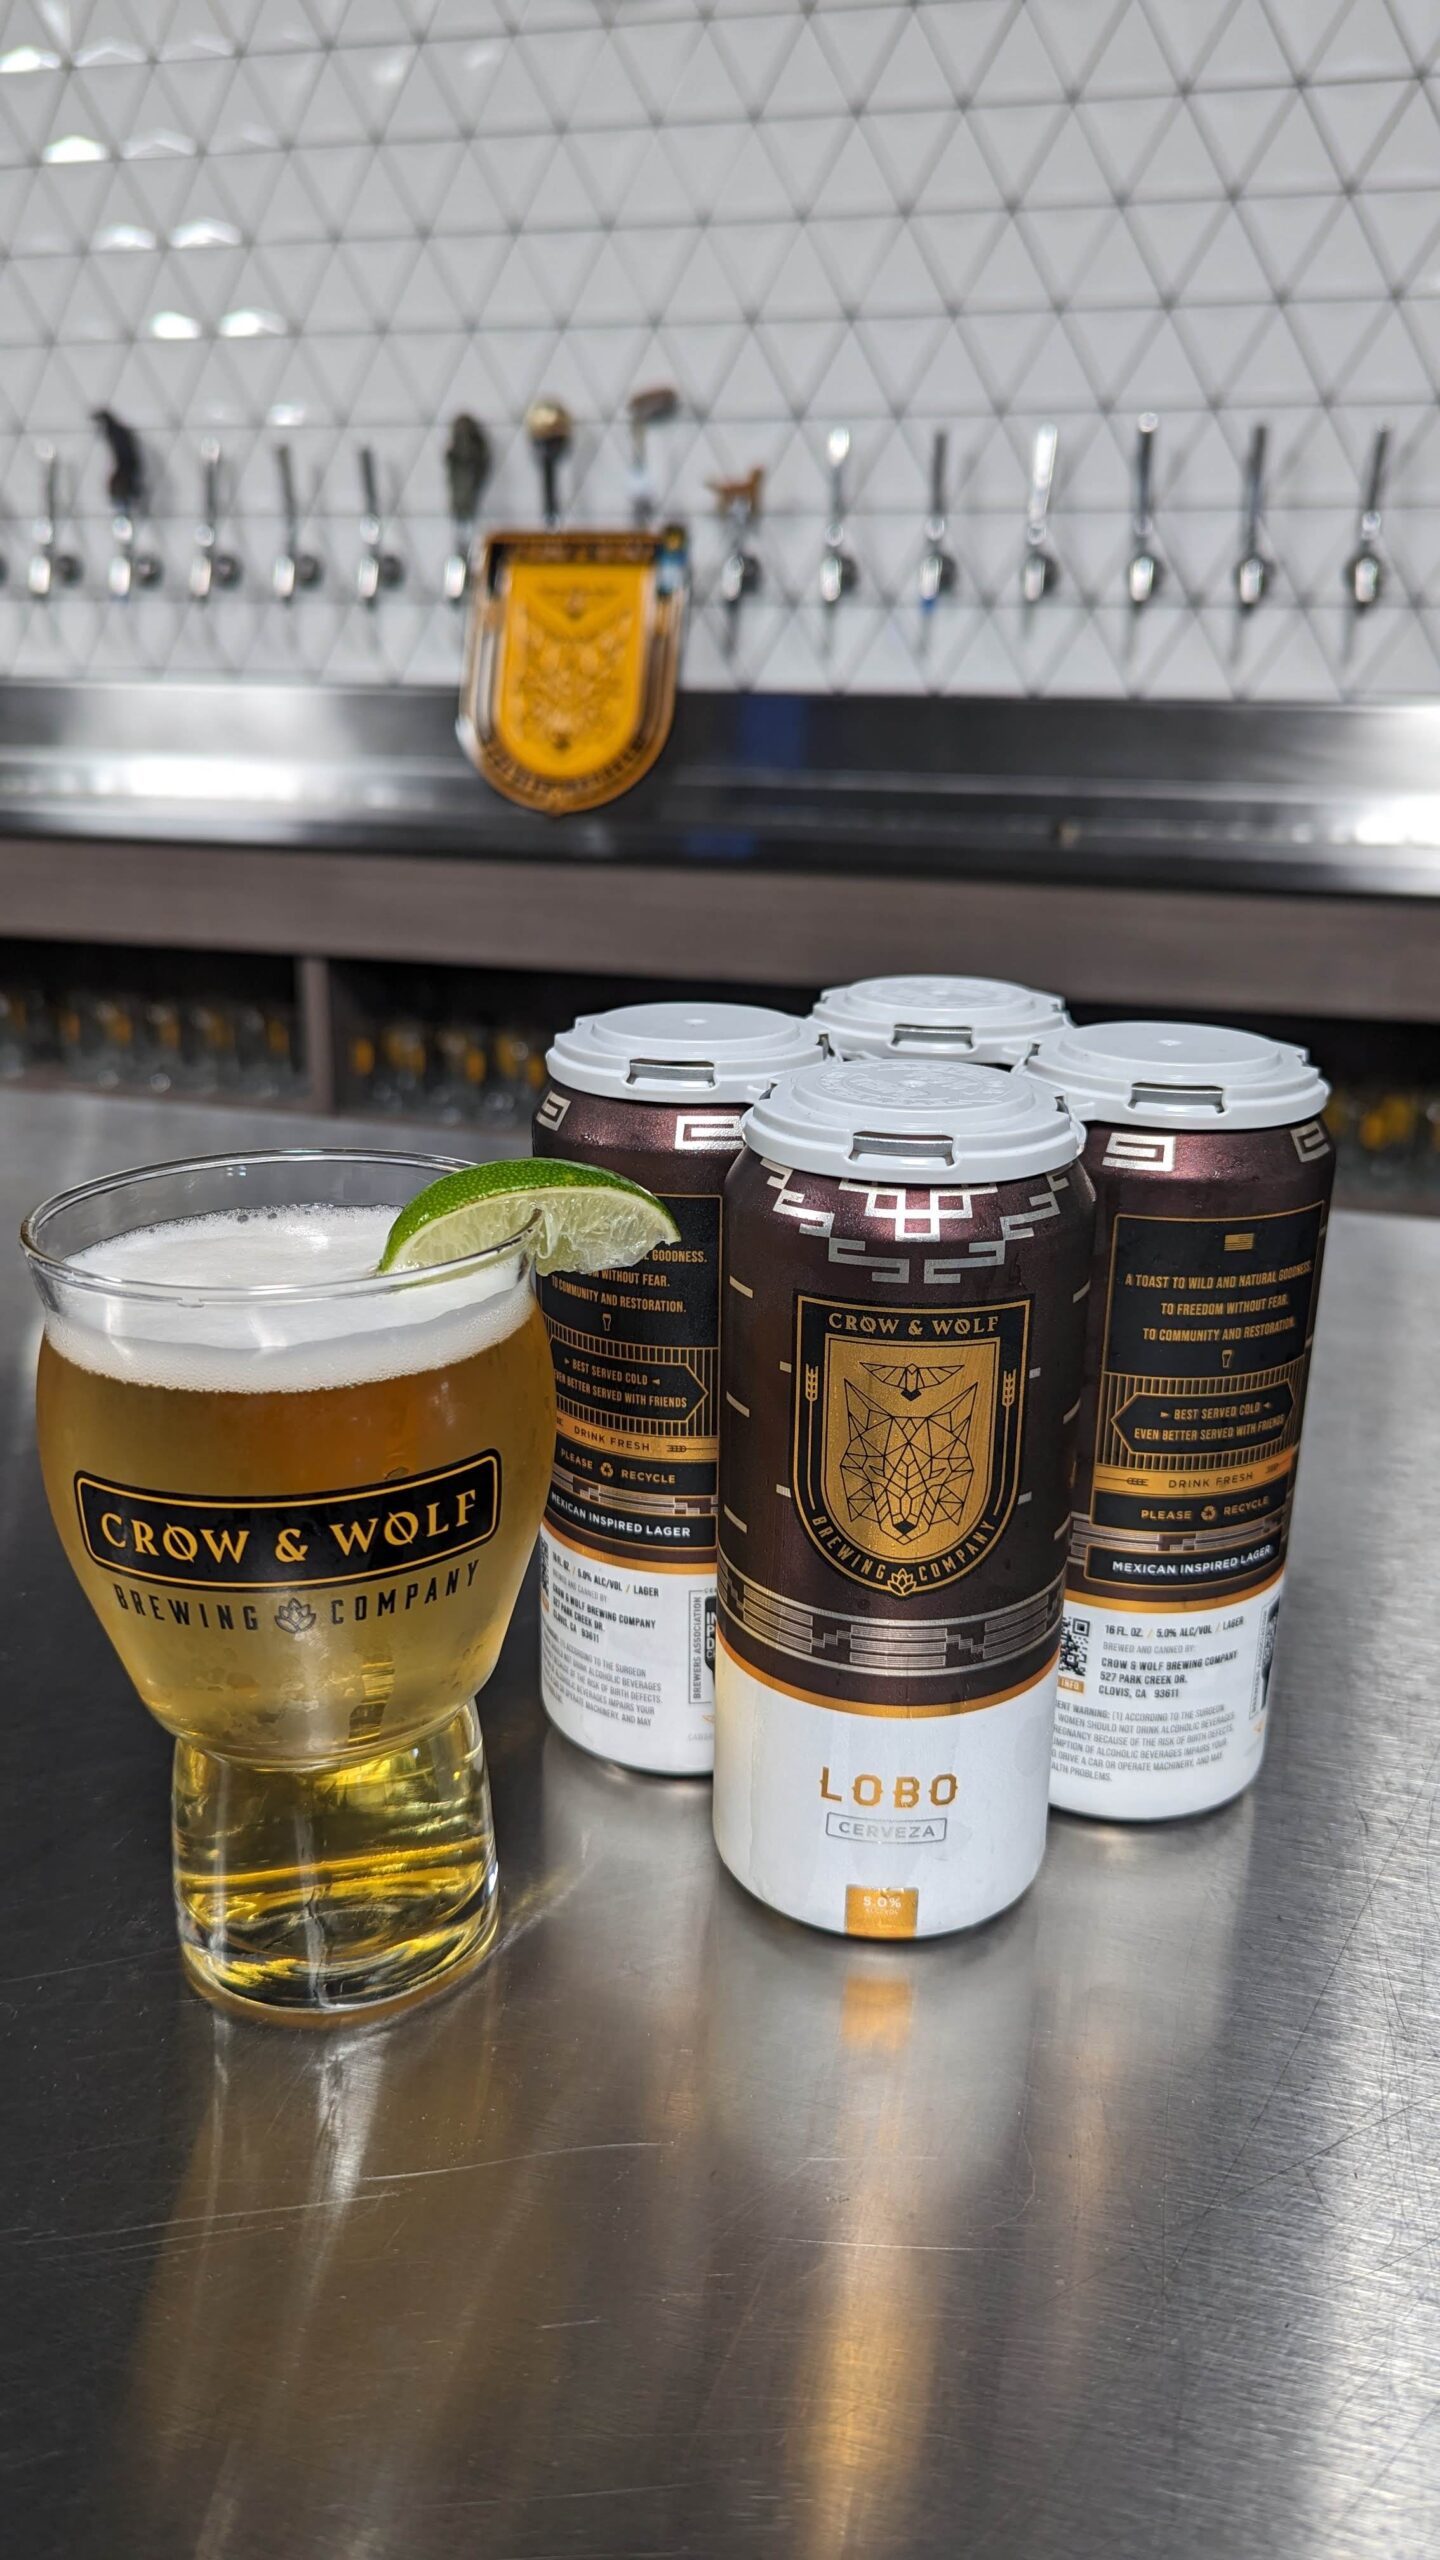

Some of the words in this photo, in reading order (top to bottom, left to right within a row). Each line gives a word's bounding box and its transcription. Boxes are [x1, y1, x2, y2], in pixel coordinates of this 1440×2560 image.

[652, 1250, 708, 1263] GOODNESS.
[601, 1269, 639, 1286] WITHOUT
[642, 1274, 670, 1288] FEAR.
[1125, 1273, 1132, 1285] A
[1136, 1274, 1169, 1288] TOAST
[1172, 1276, 1185, 1289] TO
[1188, 1277, 1213, 1289] WILD
[1216, 1275, 1236, 1288] AND
[1238, 1271, 1277, 1287] NATURAL
[559, 1279, 599, 1303] COMMUNITY
[601, 1293, 618, 1307] AND
[620, 1295, 687, 1313] RESTORATION.
[1161, 1303, 1173, 1315] TO
[1176, 1303, 1223, 1316] FREEDOM
[1227, 1297, 1267, 1315] WITHOUT
[1267, 1294, 1289, 1308] FEAR.
[829, 1312, 899, 1334] CROW
[908, 1319, 923, 1335] &
[932, 1316, 999, 1335] WOLF
[1143, 1328, 1156, 1340] TO
[1159, 1329, 1220, 1342] COMMUNITY
[1221, 1328, 1241, 1341] AND
[572, 1358, 589, 1373] BEST
[591, 1365, 623, 1382] SERVED
[625, 1372, 648, 1386] COLD
[567, 1375, 591, 1394] BETTER
[592, 1385, 622, 1402] SERVED
[624, 1394, 646, 1406] WITH
[649, 1396, 687, 1408] FRIENDS
[1174, 1408, 1199, 1421] BEST
[1201, 1405, 1237, 1419] SERVED
[1239, 1401, 1261, 1415] COLD
[574, 1426, 606, 1444] DRINK
[610, 1438, 650, 1451] FRESH
[1134, 1428, 1160, 1440] EVEN
[1162, 1430, 1197, 1442] BETTER
[1200, 1427, 1234, 1440] SERVED
[1236, 1422, 1256, 1435] WITH
[1257, 1413, 1286, 1431] FRIENDS
[560, 1448, 593, 1470] PLEASE
[621, 1469, 676, 1484] RECYCLE
[1168, 1477, 1210, 1489] DRINK
[1216, 1472, 1253, 1487] FRESH
[551, 1492, 586, 1519] MEXICAN
[589, 1512, 642, 1533] INSPIRED
[646, 1525, 691, 1537] LAGER
[1141, 1510, 1193, 1520] PLEASE
[1224, 1496, 1270, 1516] RECYCLE
[101, 1512, 250, 1564] CROW
[275, 1528, 308, 1562] &
[329, 1489, 476, 1557] WOLF
[812, 1515, 885, 1578] BREWING
[919, 1520, 996, 1581] COMPANY
[1112, 1561, 1178, 1575] MEXICAN
[1180, 1556, 1239, 1574] INSPIRED
[1240, 1544, 1271, 1565] LAGER
[113, 1584, 259, 1631] BREWING
[331, 1559, 480, 1625] COMPANY
[594, 1575, 622, 1591] ALC/VOL
[633, 1585, 659, 1597] LAGER
[574, 1610, 592, 1627] CREEK
[587, 1603, 617, 1622] BREWING
[619, 1614, 656, 1629] COMPANY
[693, 1597, 701, 1653] ASSOCIATION
[1105, 1625, 1115, 1634] 16
[1131, 1628, 1143, 1637] OZ.
[1156, 1629, 1176, 1637] 5.0%
[1180, 1625, 1212, 1636] ALC/VOL
[1223, 1616, 1244, 1631] LAGER
[1103, 1642, 1135, 1653] BREWED
[1136, 1645, 1151, 1654] AND
[1154, 1645, 1182, 1654] CANNED
[616, 1663, 646, 1678] SURGEON
[1101, 1658, 1130, 1669] CROW
[1130, 1661, 1136, 1670] &
[1140, 1661, 1163, 1671] WOLF
[1166, 1659, 1203, 1670] BREWING
[1205, 1649, 1238, 1665] COMPANY
[693, 1660, 701, 1699] BREWERS
[1100, 1671, 1116, 1682] 527
[1119, 1674, 1142, 1685] PARK
[1145, 1675, 1171, 1685] CREEK
[1174, 1674, 1188, 1683] DR.
[1099, 1685, 1132, 1698] CLOVIS,
[1135, 1689, 1146, 1698] CA
[1154, 1689, 1179, 1698] 93611
[1072, 1704, 1110, 1719] WARNING:
[1058, 1713, 1085, 1728] WOMEN
[1087, 1720, 1117, 1732] SHOULD
[1119, 1724, 1134, 1734] NOT
[819, 1766, 958, 1808] LOBO
[839, 1821, 935, 1839] CERVEZA
